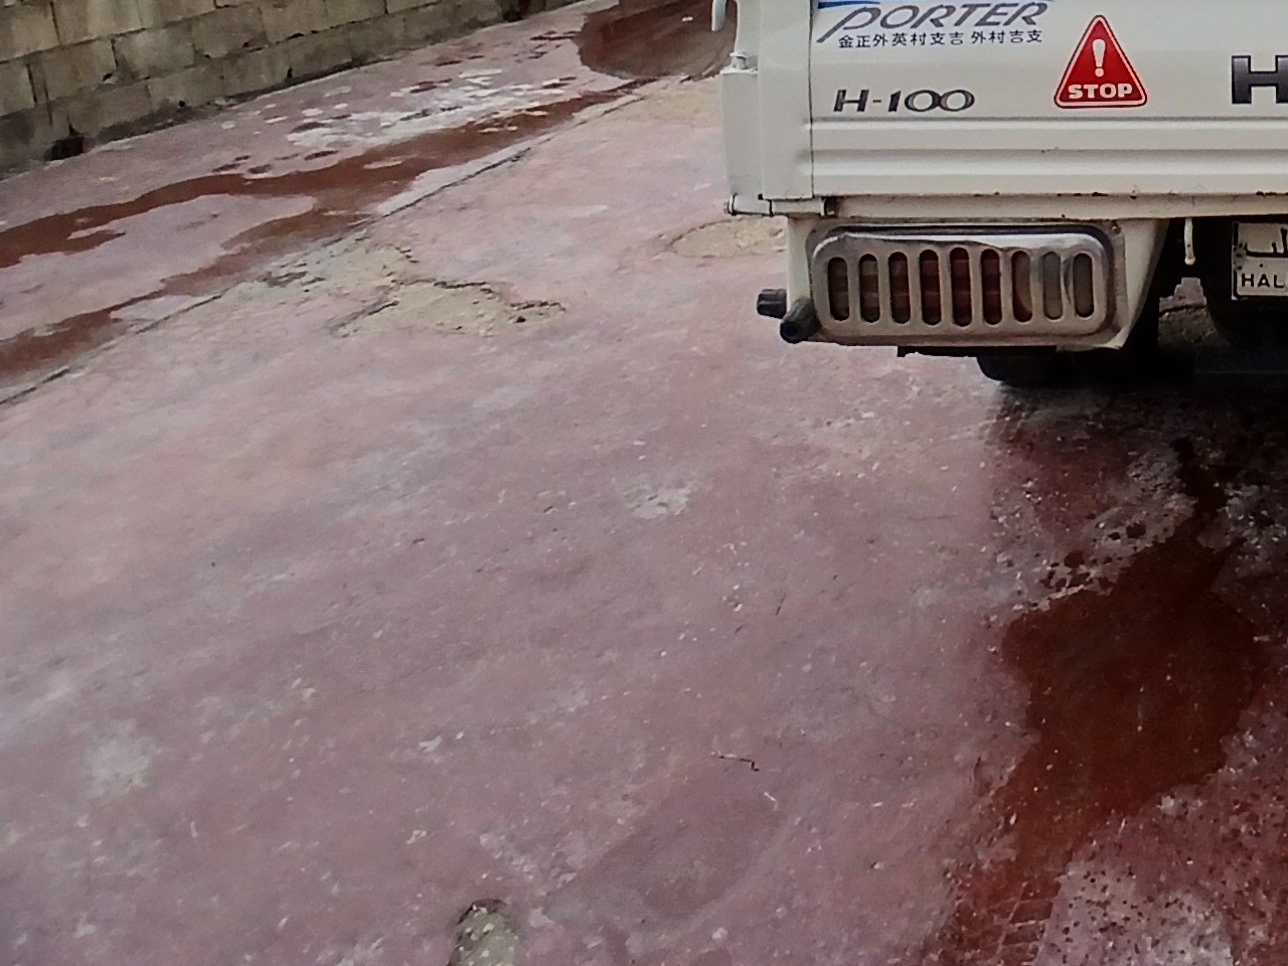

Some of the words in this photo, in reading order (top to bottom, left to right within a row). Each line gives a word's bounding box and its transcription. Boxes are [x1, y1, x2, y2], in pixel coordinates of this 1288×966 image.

[816, 1, 1048, 43] PORTER
[833, 88, 976, 113] H-100
[1068, 83, 1133, 99] STOP
